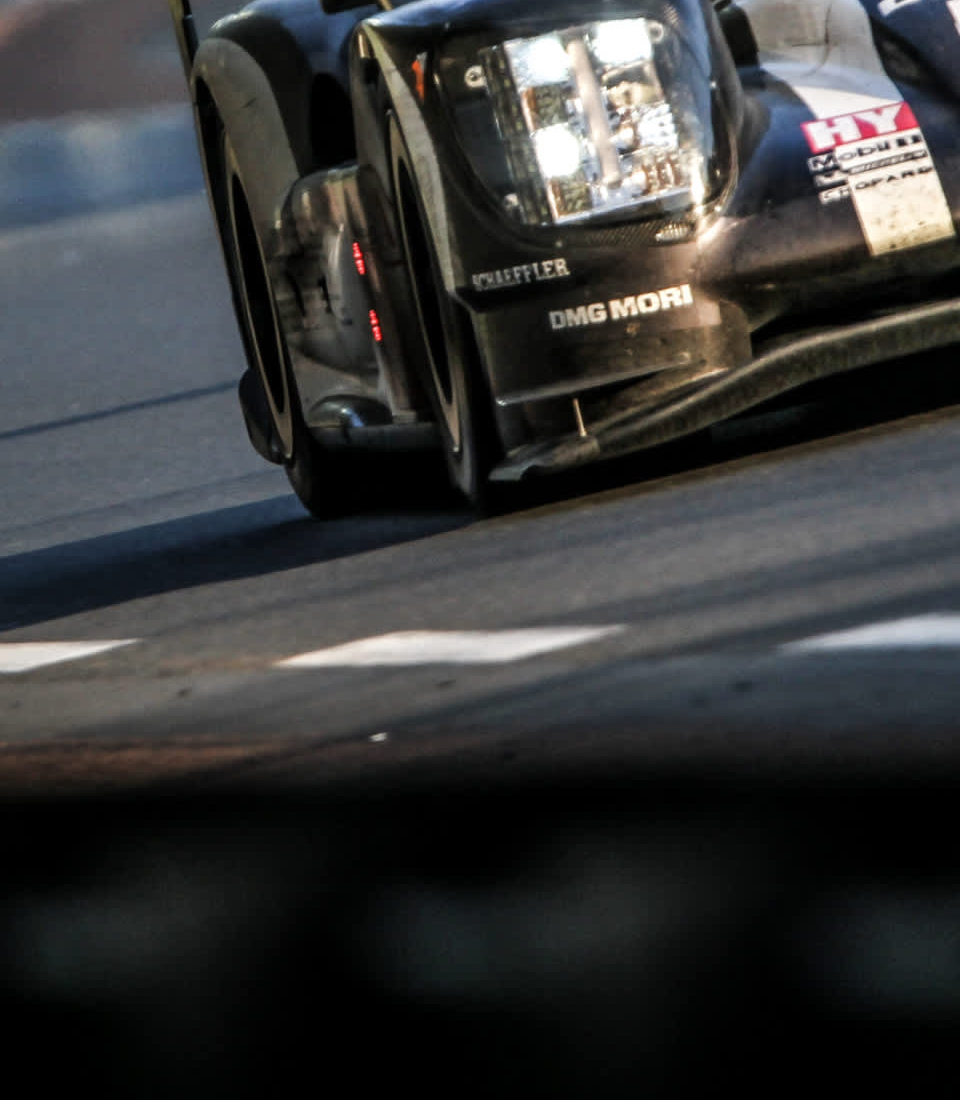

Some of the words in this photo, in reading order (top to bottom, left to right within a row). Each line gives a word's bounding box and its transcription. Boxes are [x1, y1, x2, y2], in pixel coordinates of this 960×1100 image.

[807, 102, 903, 150] HY
[471, 257, 571, 292] SCHAEFFLER
[549, 302, 607, 330] DMG
[608, 284, 694, 320] MORI
